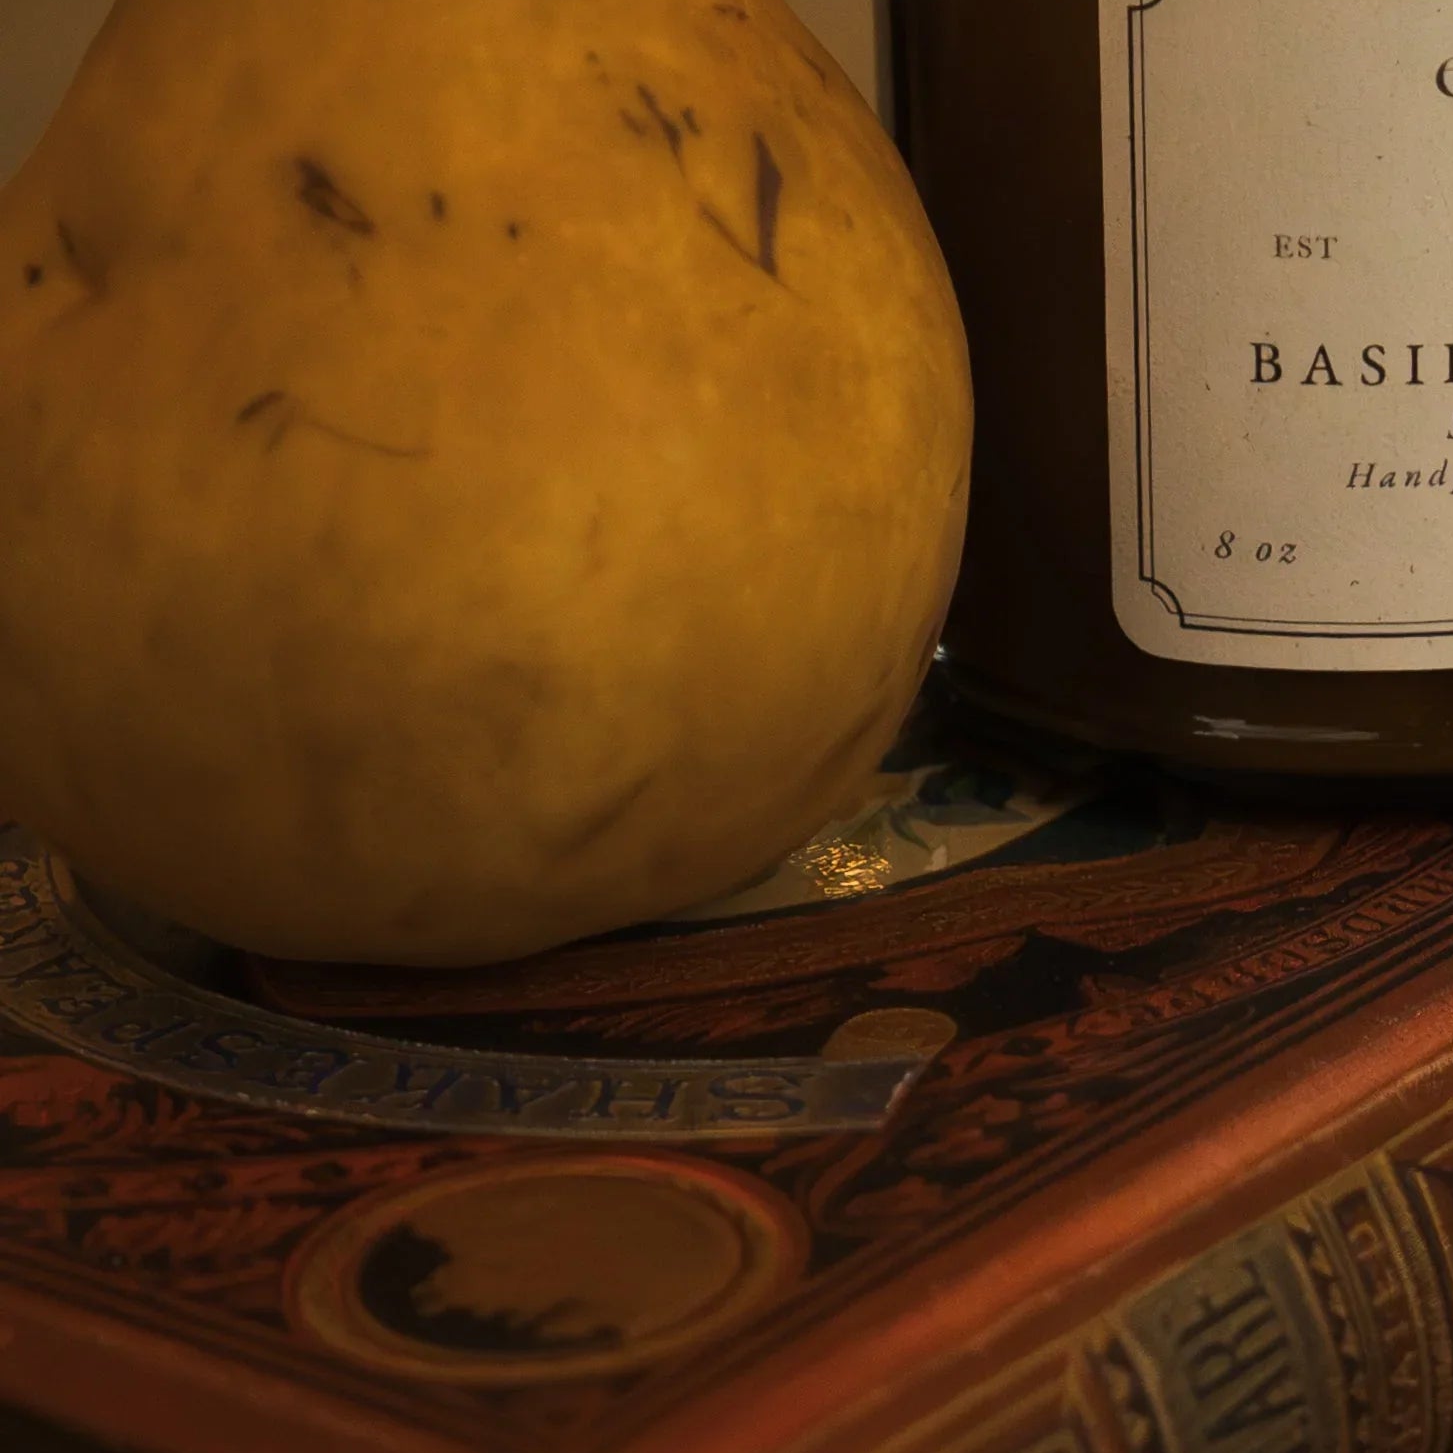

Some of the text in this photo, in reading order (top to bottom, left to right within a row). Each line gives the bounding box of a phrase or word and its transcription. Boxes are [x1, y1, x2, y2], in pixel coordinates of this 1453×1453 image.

[1273, 233, 1338, 260] EST
[1214, 529, 1298, 565] 8 oz
